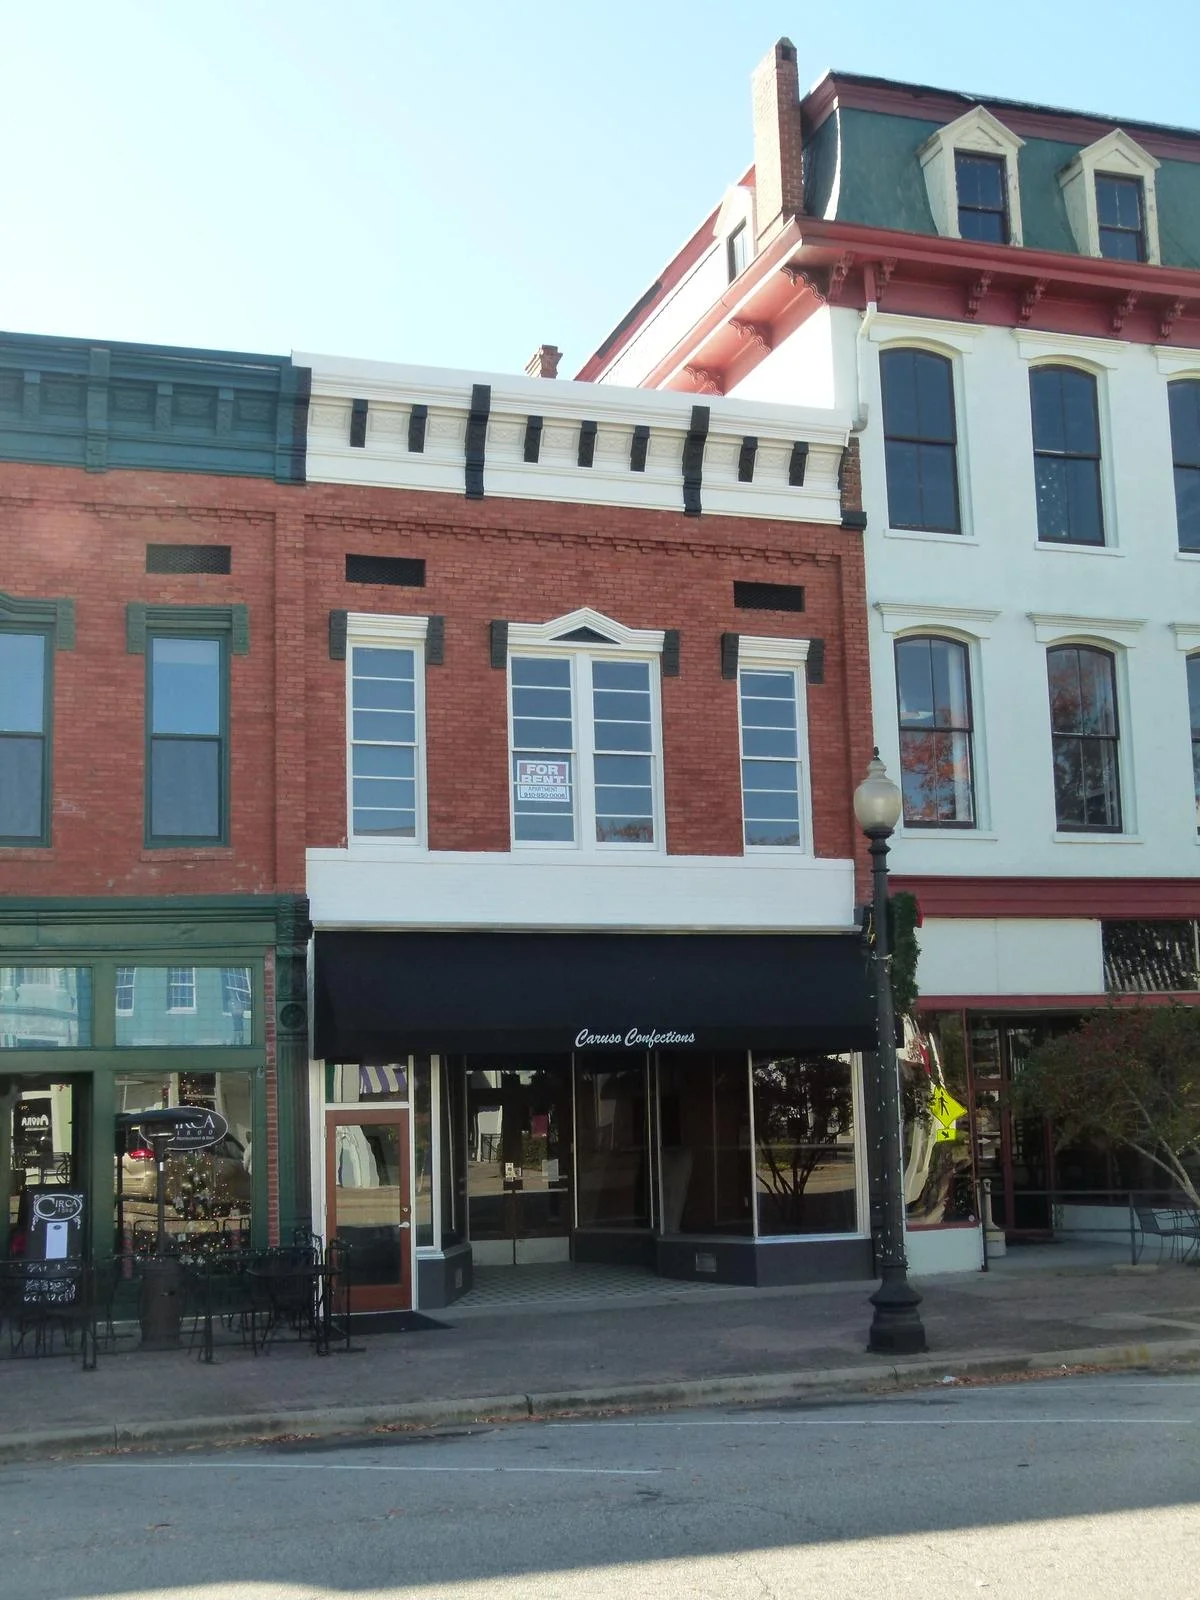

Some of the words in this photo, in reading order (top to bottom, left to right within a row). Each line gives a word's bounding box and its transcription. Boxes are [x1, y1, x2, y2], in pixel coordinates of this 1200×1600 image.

[526, 764, 559, 775] FOR
[521, 775, 565, 785] RENT
[575, 1028, 622, 1047] Caruso
[624, 1027, 696, 1048] Confections
